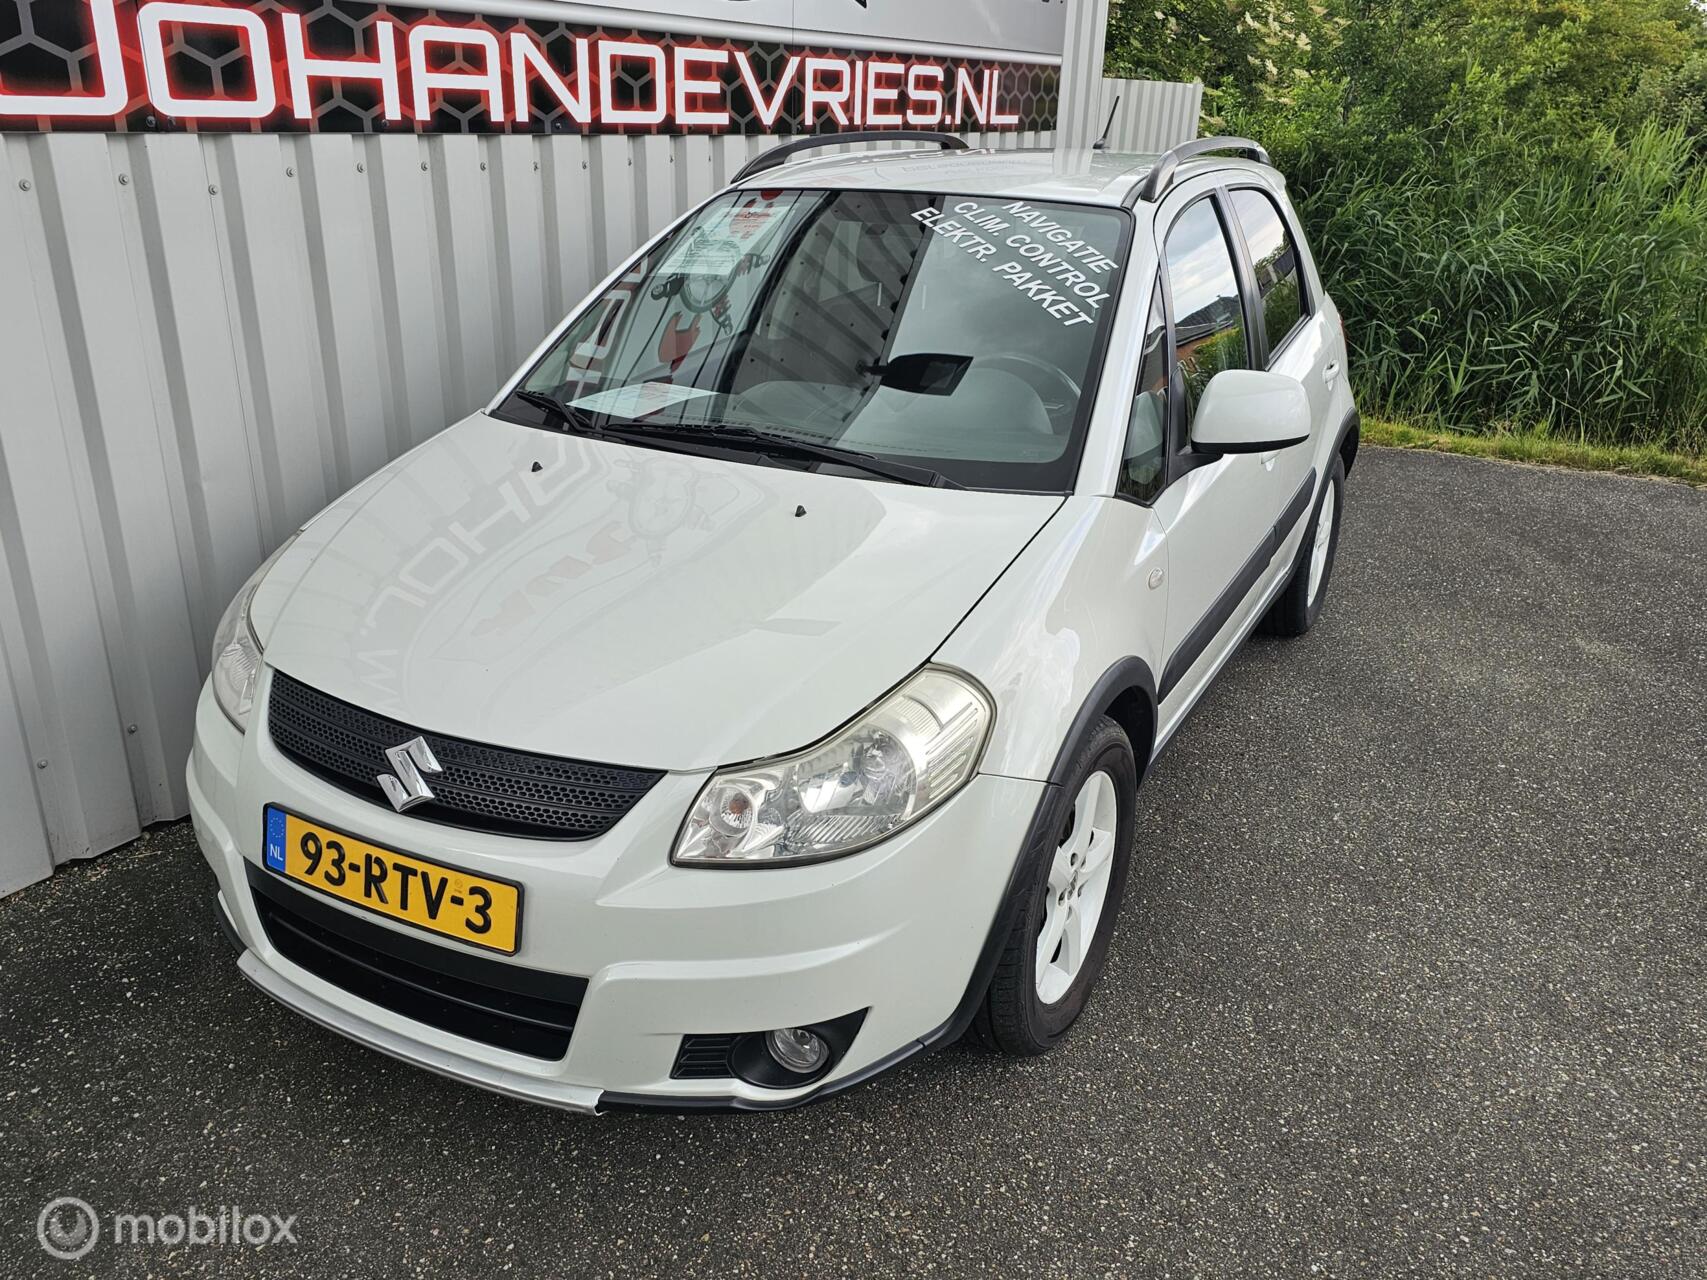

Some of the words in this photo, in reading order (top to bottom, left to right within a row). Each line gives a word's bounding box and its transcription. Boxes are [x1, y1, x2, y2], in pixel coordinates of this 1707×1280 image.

[910, 207, 998, 263] ELEKTR.
[991, 261, 1094, 326] PAKKET
[953, 202, 1010, 236] CLIM.
[1005, 234, 1110, 309] CONTROL
[1001, 201, 1118, 274] NAVIGATIE
[269, 843, 284, 861] NL
[300, 831, 492, 934] 93-RTV-3
